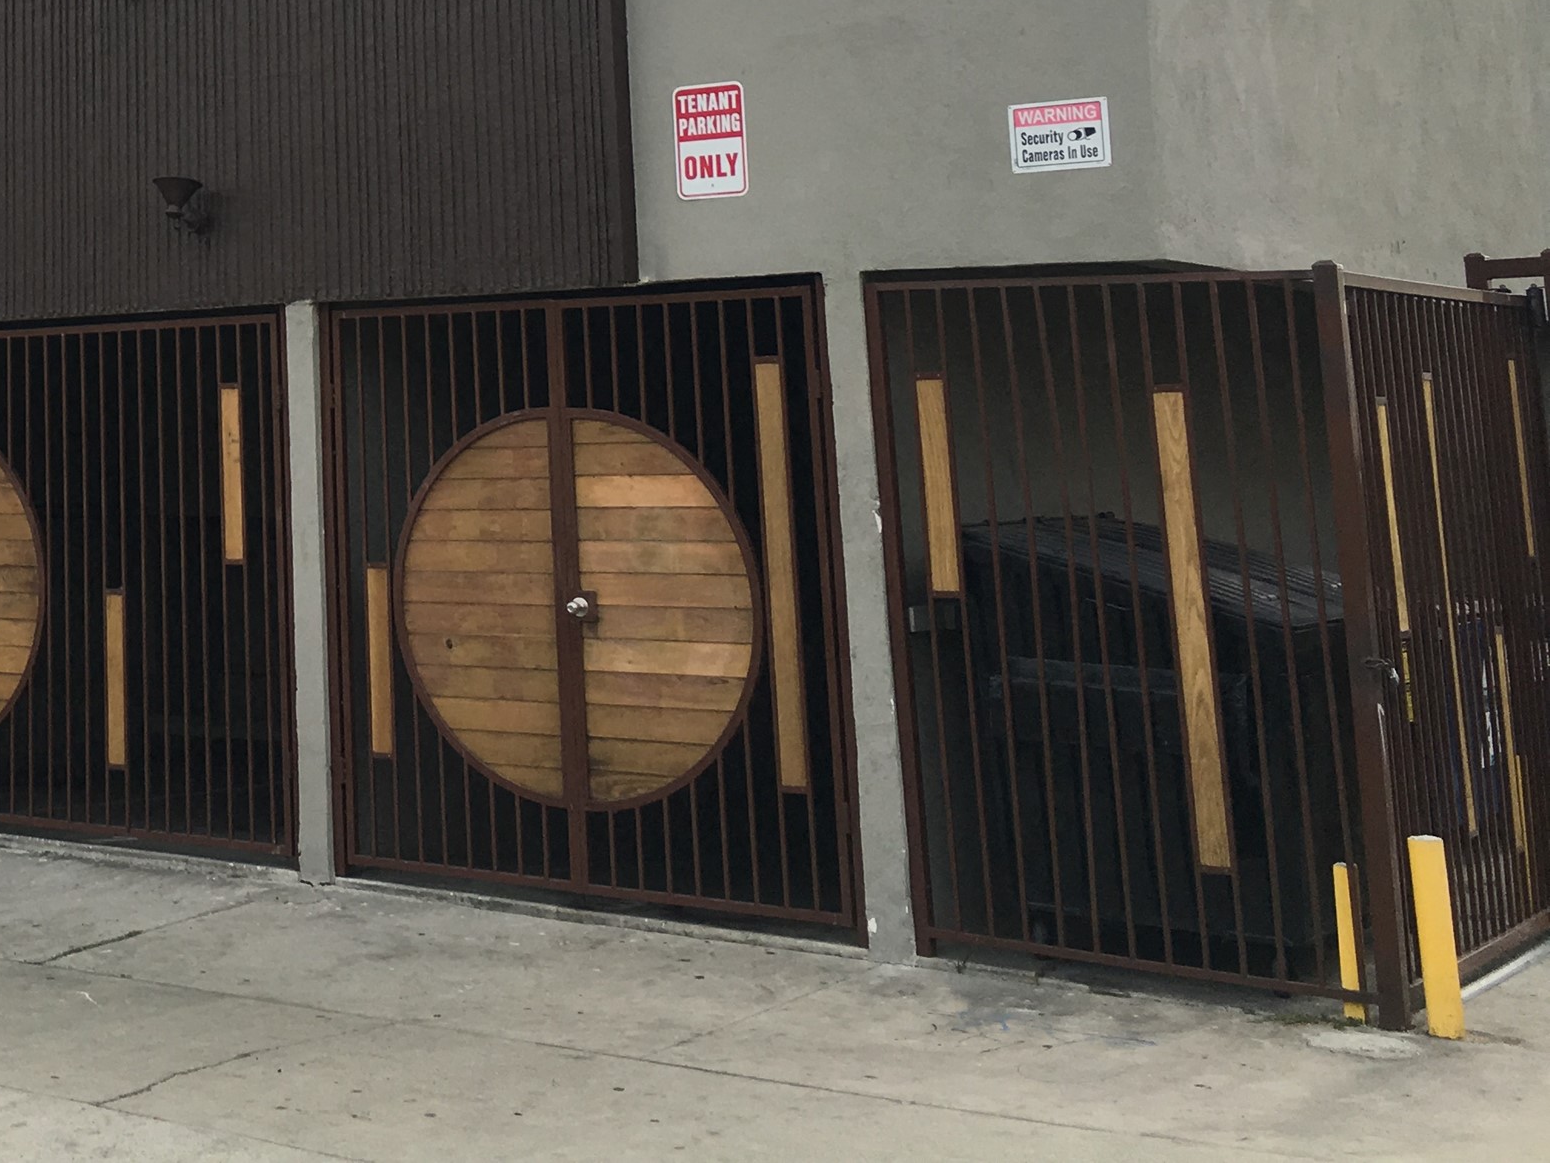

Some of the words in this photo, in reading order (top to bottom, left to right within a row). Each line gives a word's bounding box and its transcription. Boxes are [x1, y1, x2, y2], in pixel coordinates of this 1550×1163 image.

[677, 90, 738, 114] TENANT
[679, 113, 741, 137] PARKING
[1017, 104, 1097, 125] WARNING
[1021, 130, 1064, 146] Security
[1022, 149, 1065, 163] Cameras
[1068, 146, 1078, 159] In
[1080, 144, 1098, 158] Use
[684, 153, 738, 180] ONLY
